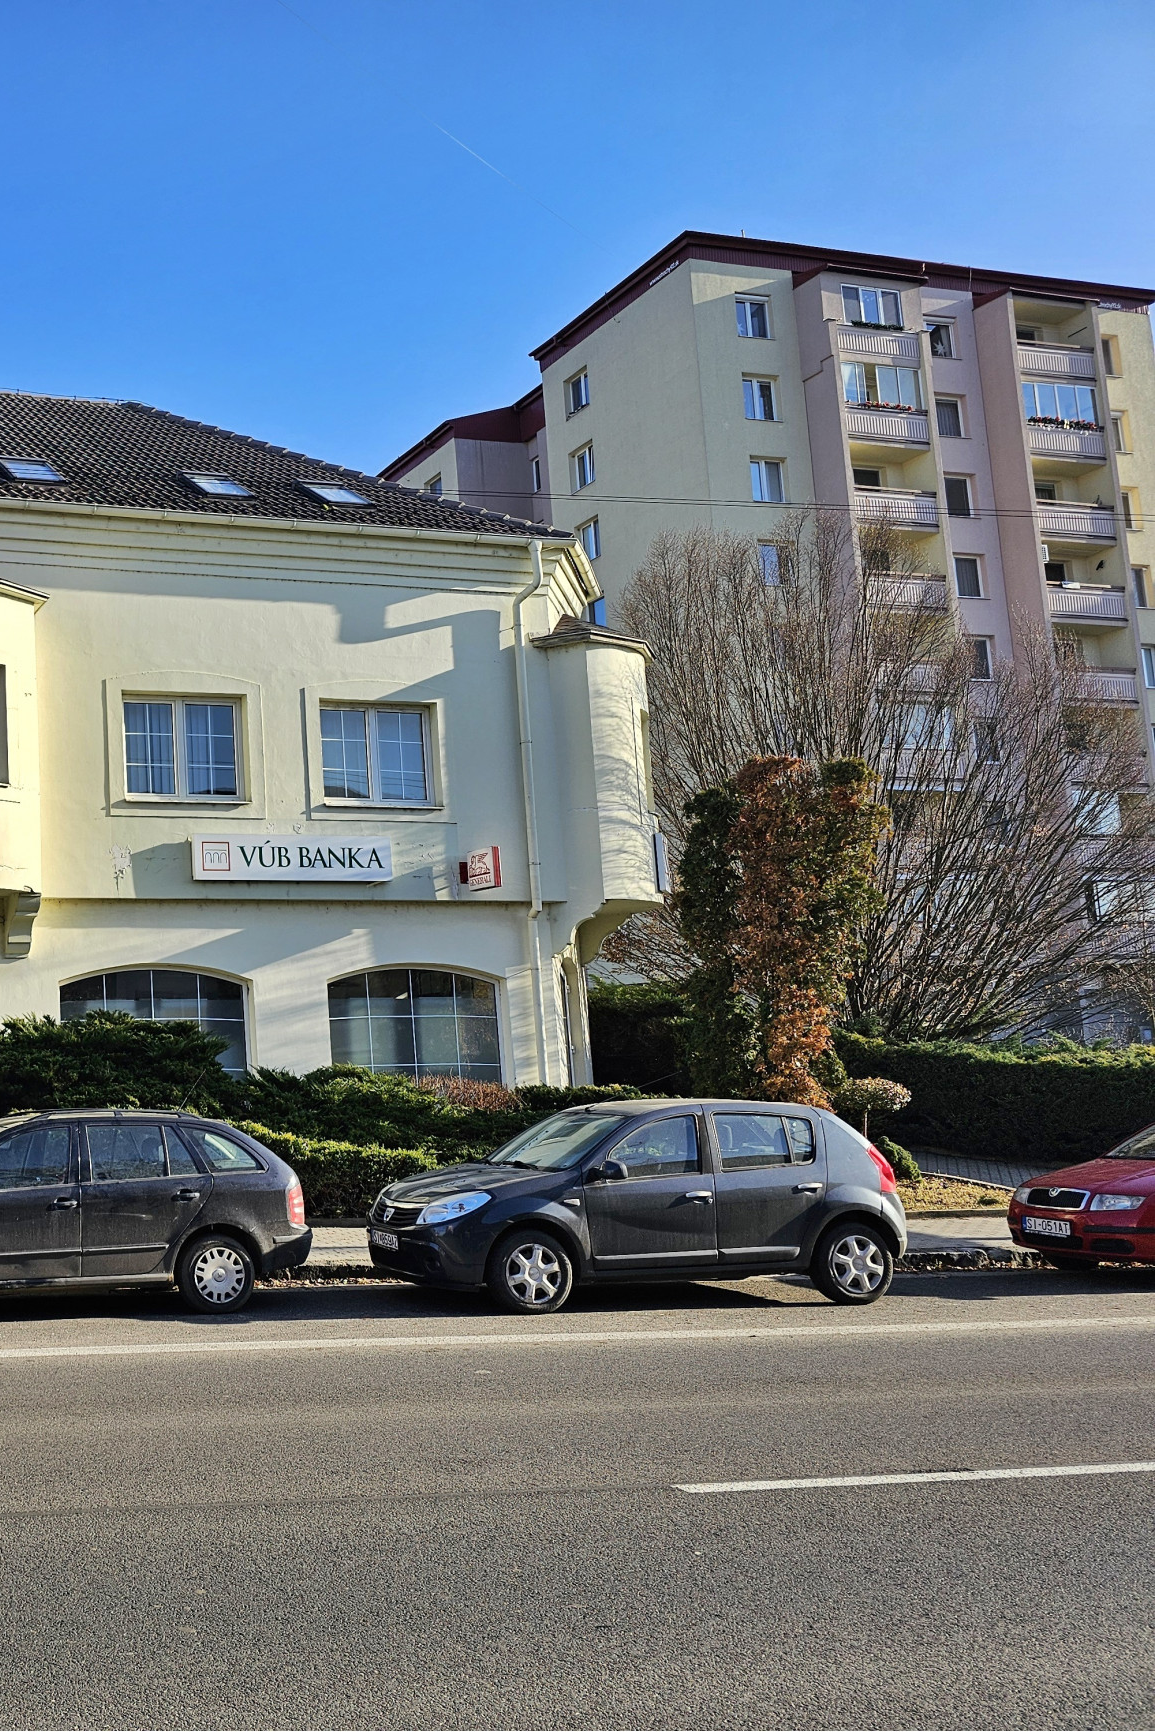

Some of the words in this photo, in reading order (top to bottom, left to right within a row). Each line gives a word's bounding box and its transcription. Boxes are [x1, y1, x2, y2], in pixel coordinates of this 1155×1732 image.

[237, 840, 291, 868] VÚB
[297, 846, 386, 869] BANKA
[469, 875, 492, 886] GENERALI
